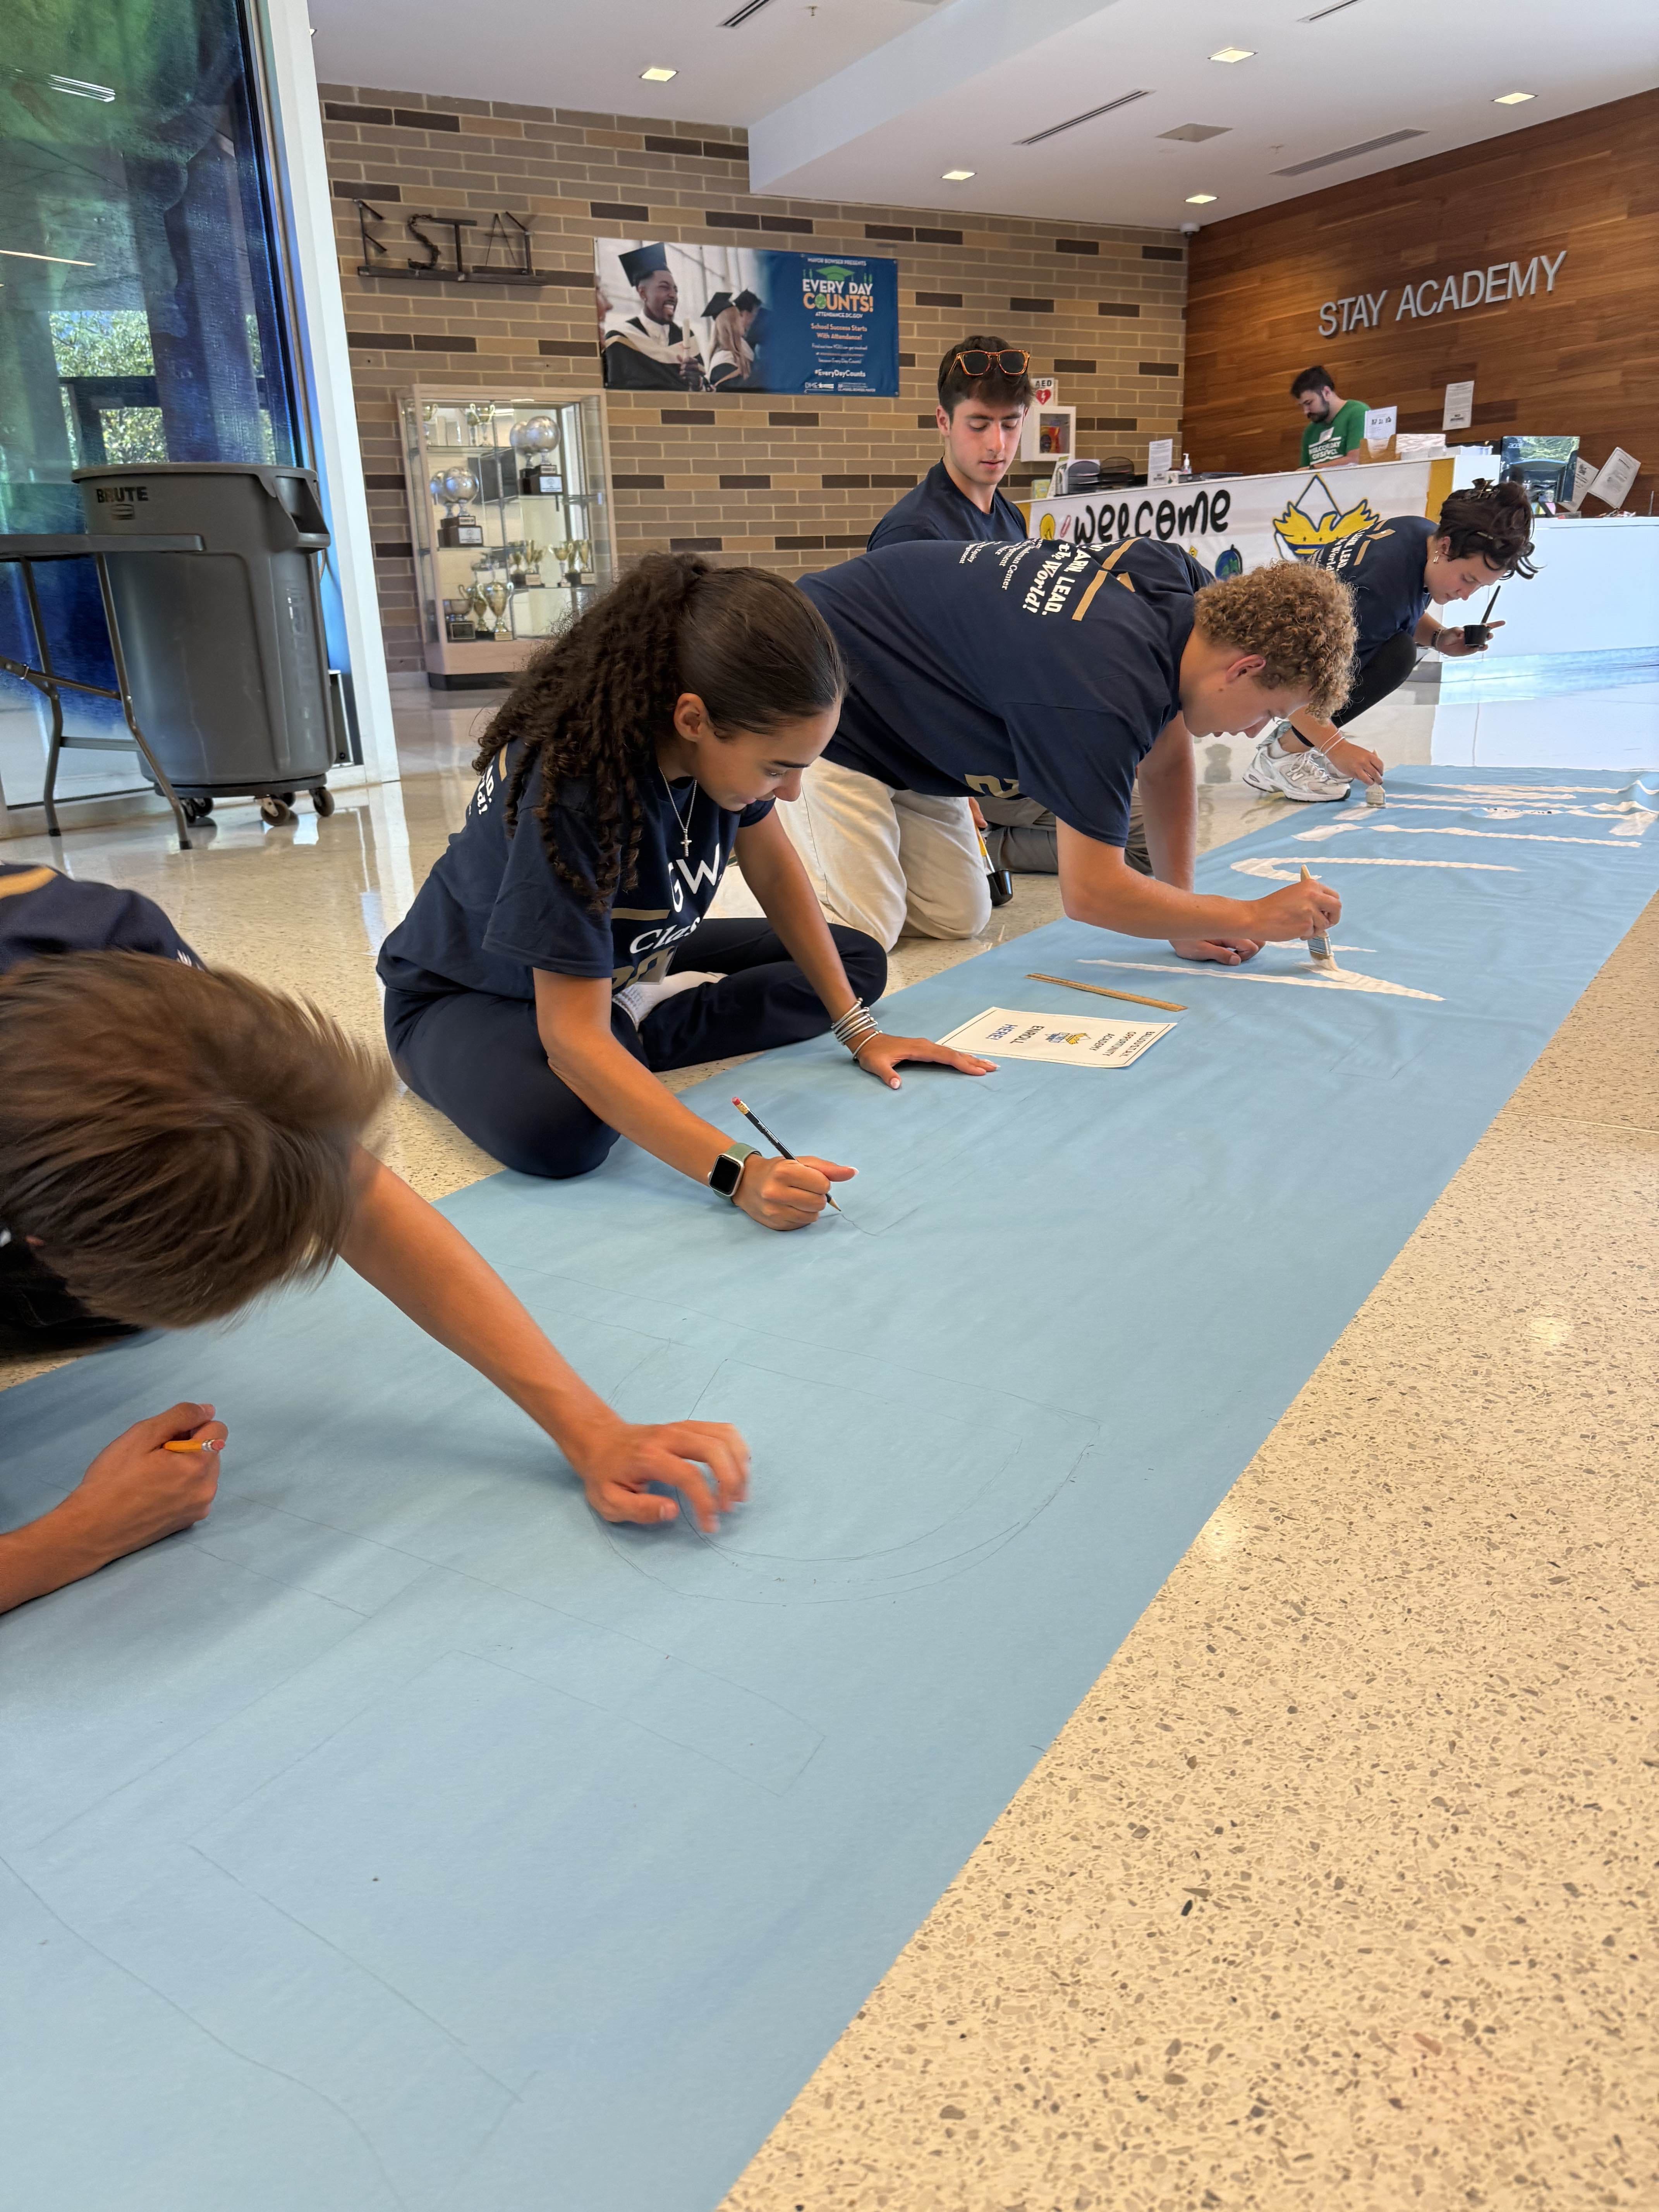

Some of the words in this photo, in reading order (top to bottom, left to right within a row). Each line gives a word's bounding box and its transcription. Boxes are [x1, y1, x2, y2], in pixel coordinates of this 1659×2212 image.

[802, 279, 845, 294] EVERY
[849, 282, 873, 295] DAY
[1319, 290, 1388, 336] STAY
[1395, 250, 1567, 321] ACADEMY
[803, 292, 874, 313] COUNTS!
[96, 486, 149, 503] BRUTE
[1063, 548, 1091, 572] ARN.
[1002, 564, 1018, 590] Center
[1022, 560, 1063, 613] World!
[1042, 576, 1075, 616] LEAD.
[985, 1024, 1018, 1040] HERE!
[1009, 1025, 1045, 1044] ENROLL
[1089, 1033, 1115, 1051] ACADEMY
[1102, 1031, 1137, 1056] OPPORTUNITY
